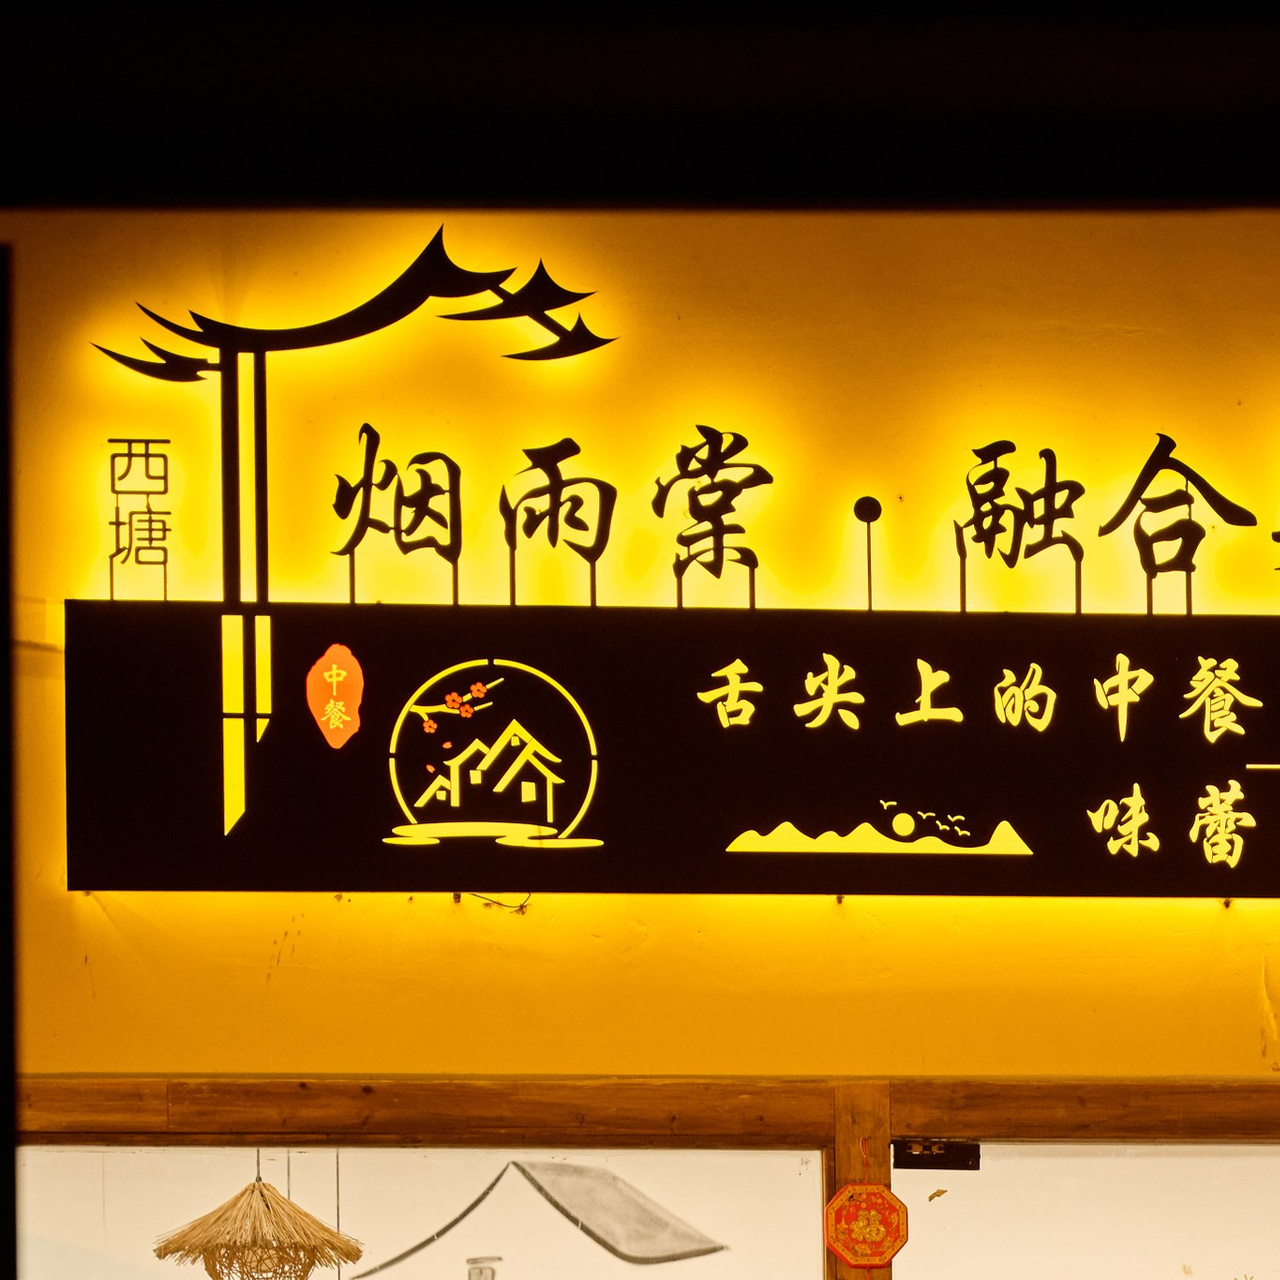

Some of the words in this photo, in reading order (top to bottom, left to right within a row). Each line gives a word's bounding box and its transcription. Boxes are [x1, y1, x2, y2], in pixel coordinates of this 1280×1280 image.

[107, 438, 172, 565] 西塘
[321, 663, 352, 731] 中餐
[697, 652, 1264, 744] 舌尖上的中餐
